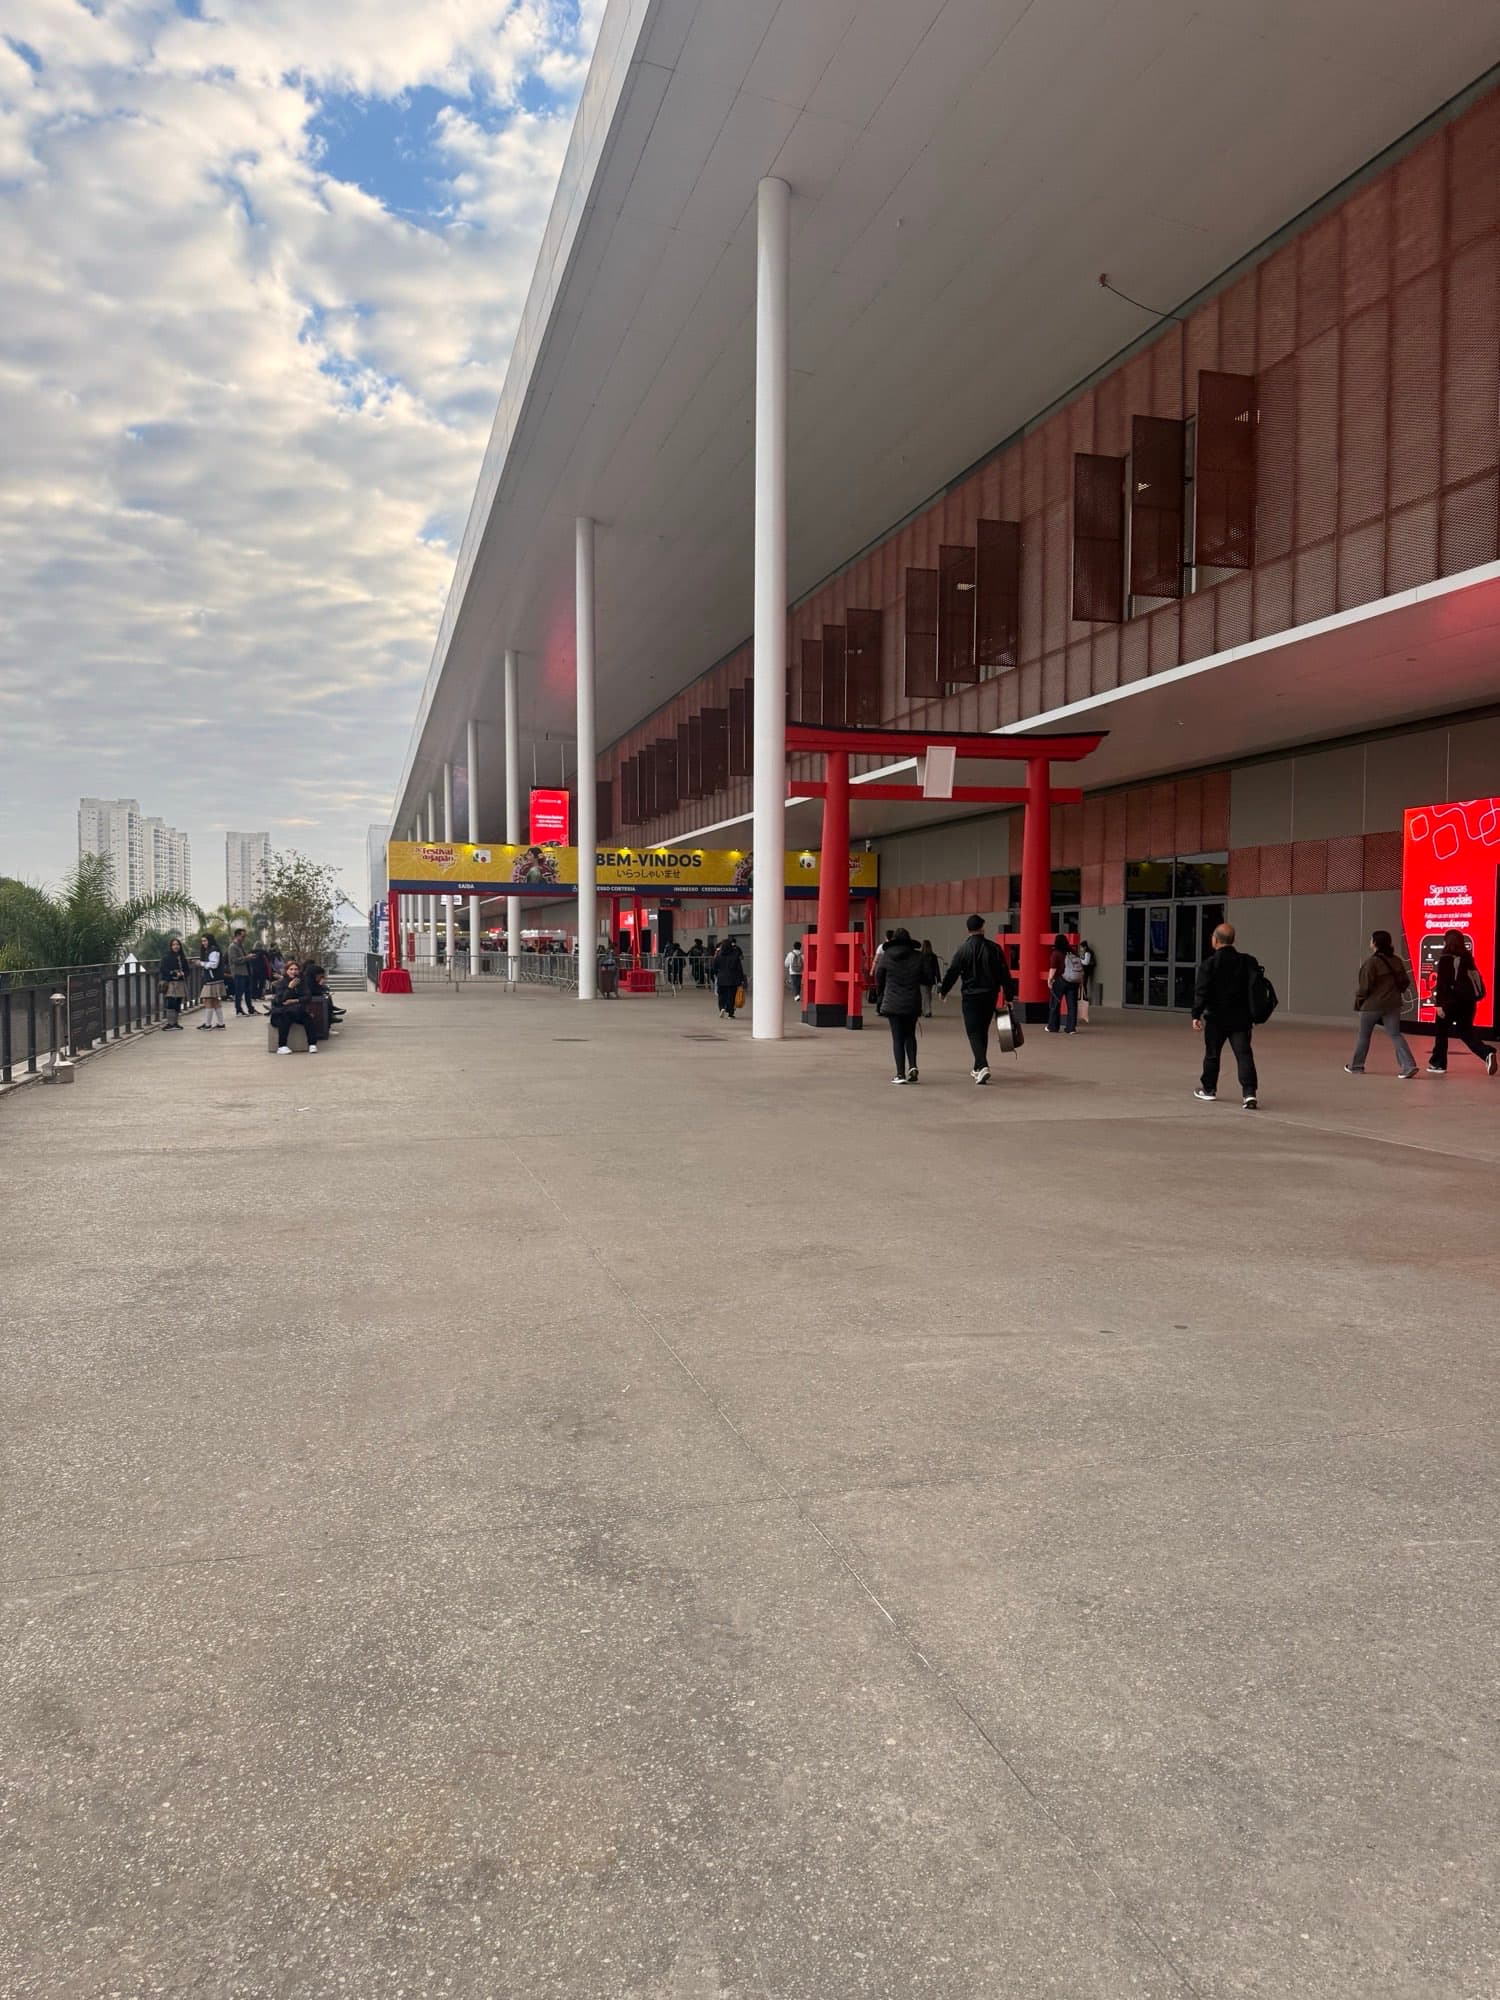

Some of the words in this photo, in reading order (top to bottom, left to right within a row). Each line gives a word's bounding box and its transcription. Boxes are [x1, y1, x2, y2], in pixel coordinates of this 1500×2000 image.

[422, 847, 454, 855] Festival
[596, 853, 702, 867] BEM-VINDOS
[616, 869, 681, 879] いらっしゃいませ
[1424, 895, 1446, 906] redes
[1446, 894, 1473, 905] sociais
